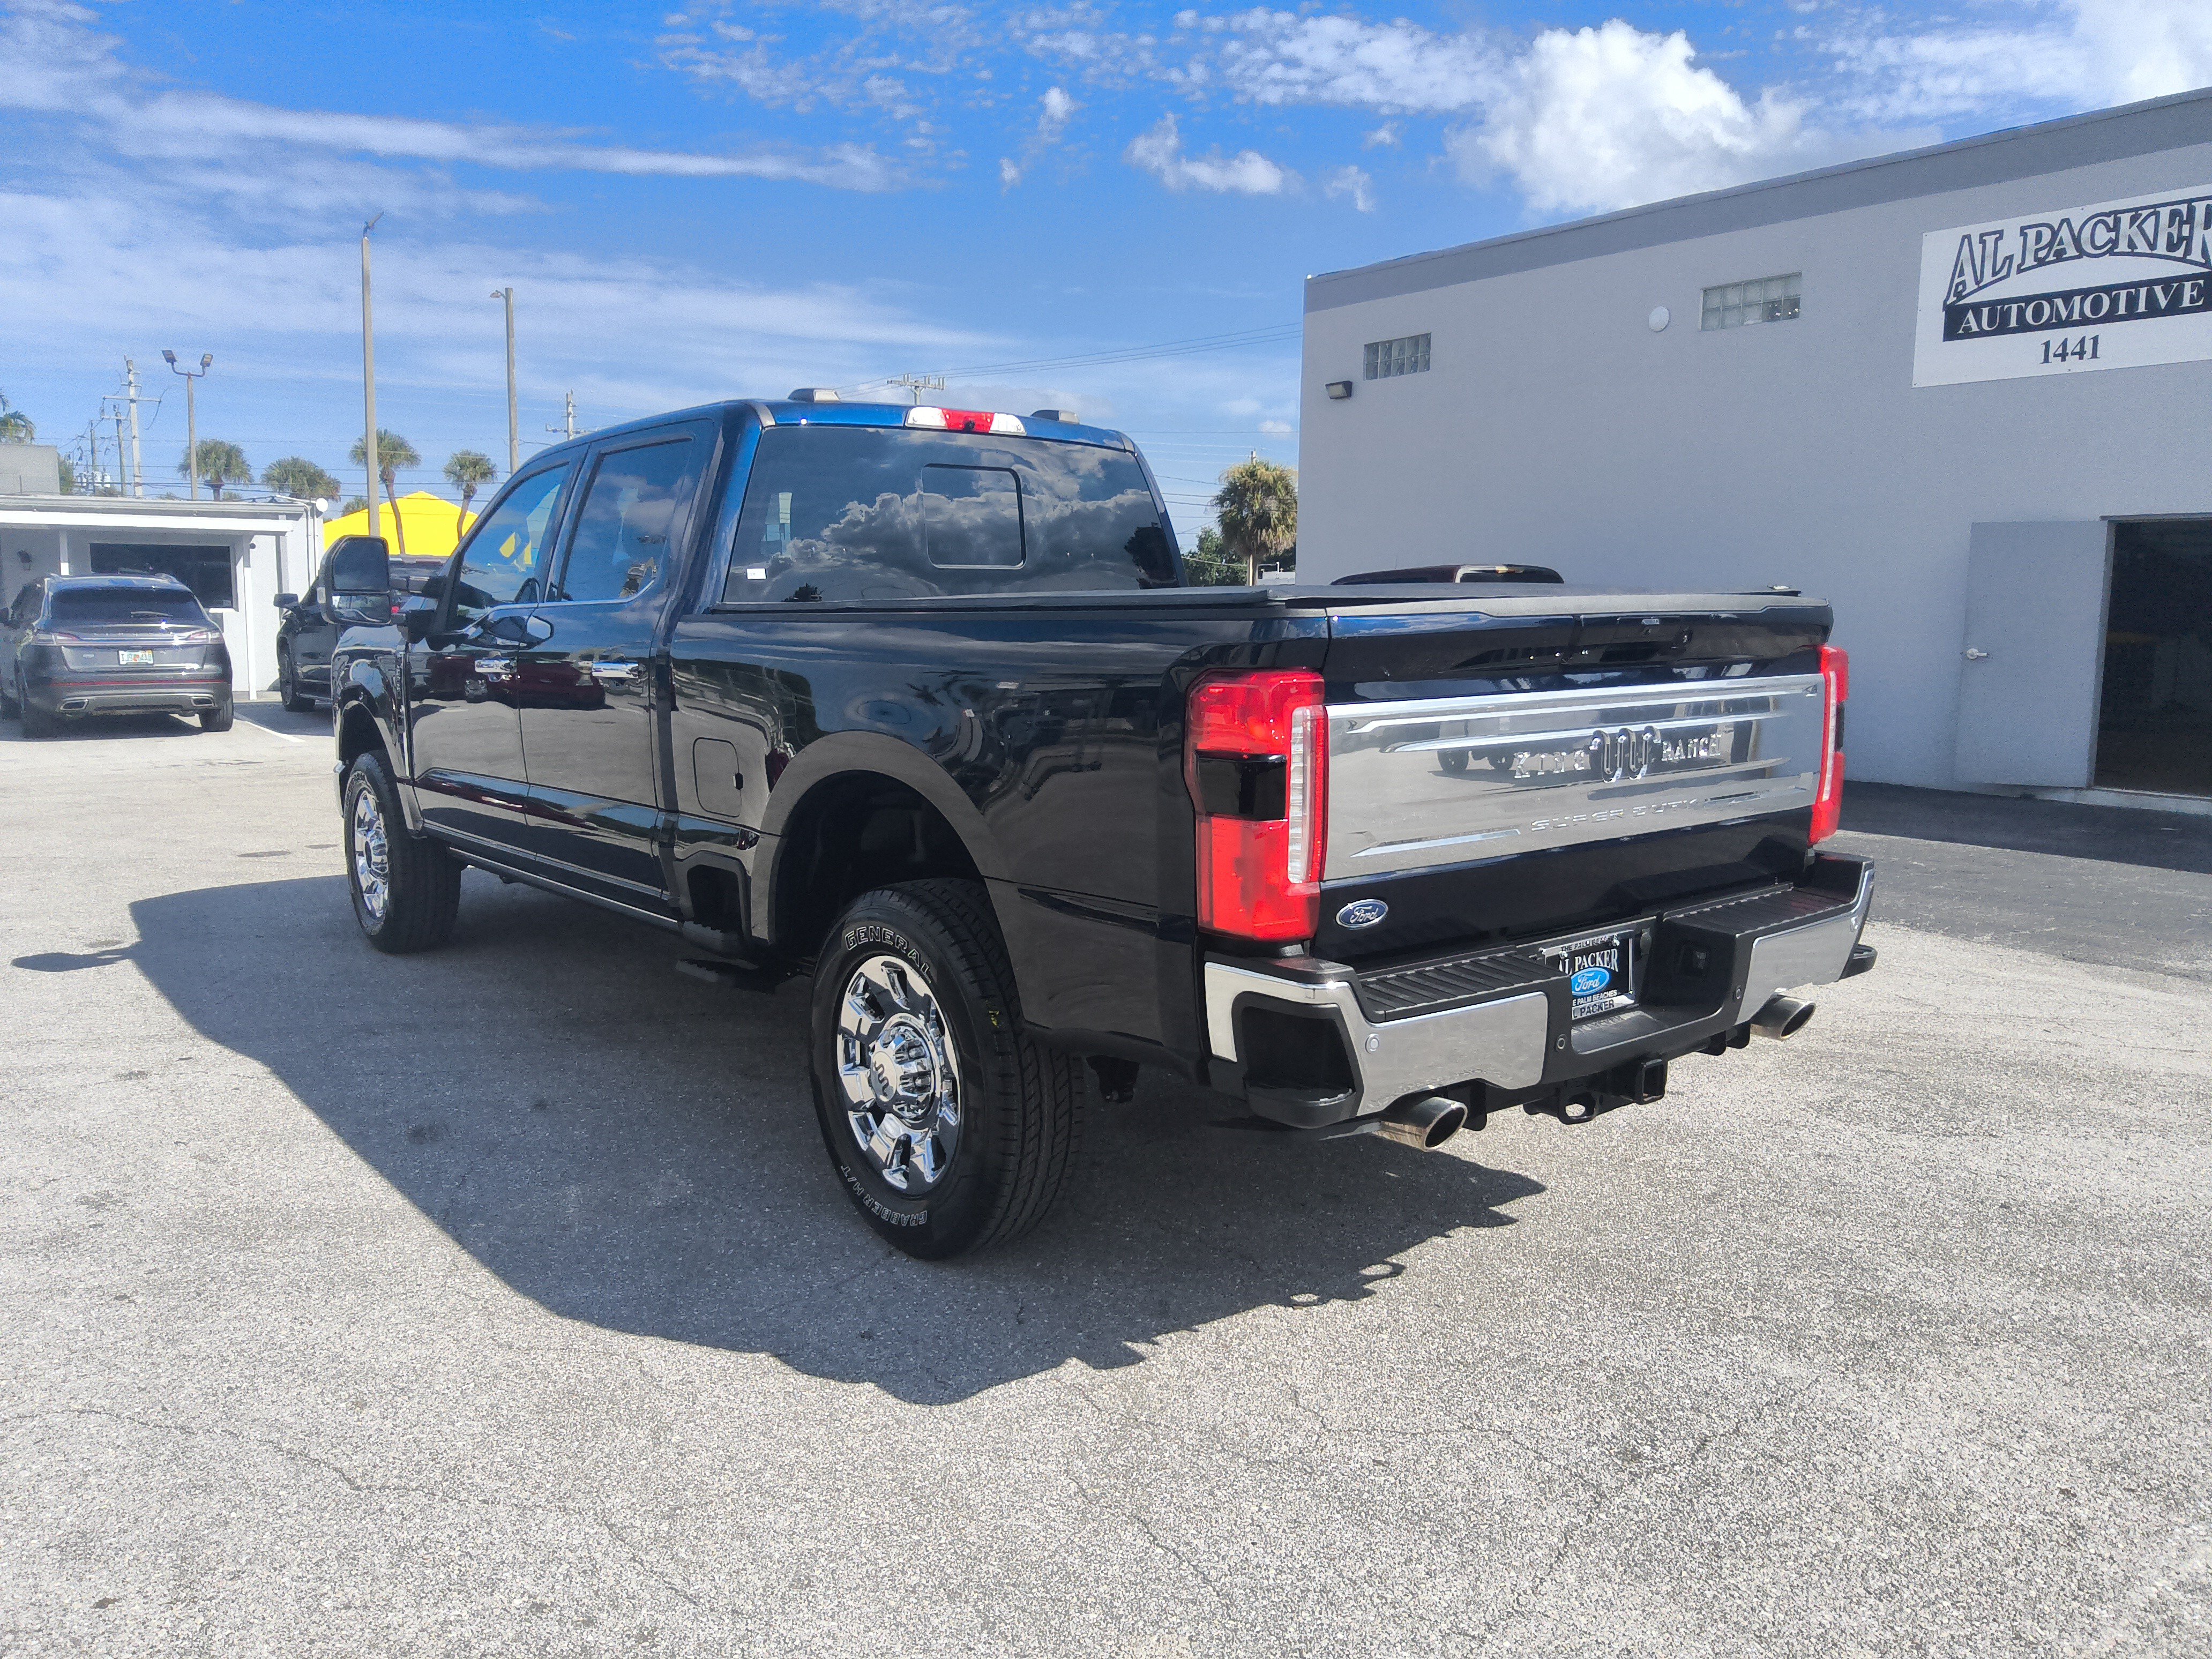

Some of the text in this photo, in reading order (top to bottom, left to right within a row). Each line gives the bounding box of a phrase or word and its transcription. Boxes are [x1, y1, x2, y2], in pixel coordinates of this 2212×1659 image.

[1945, 196, 2212, 305] AL PACKER
[1957, 279, 2204, 334] AUTOMOTIVE
[2039, 334, 2101, 364] 1441
[1514, 733, 1722, 778] KING RANCH
[845, 925, 931, 984] GENERAL
[1574, 948, 1619, 973] PACKER
[1574, 972, 1601, 991] Ford
[1577, 996, 1592, 1005] PALM
[1593, 989, 1617, 1002] BEACHES
[1580, 999, 1615, 1017] PACKER
[840, 1165, 928, 1227] GRABBER H/T
